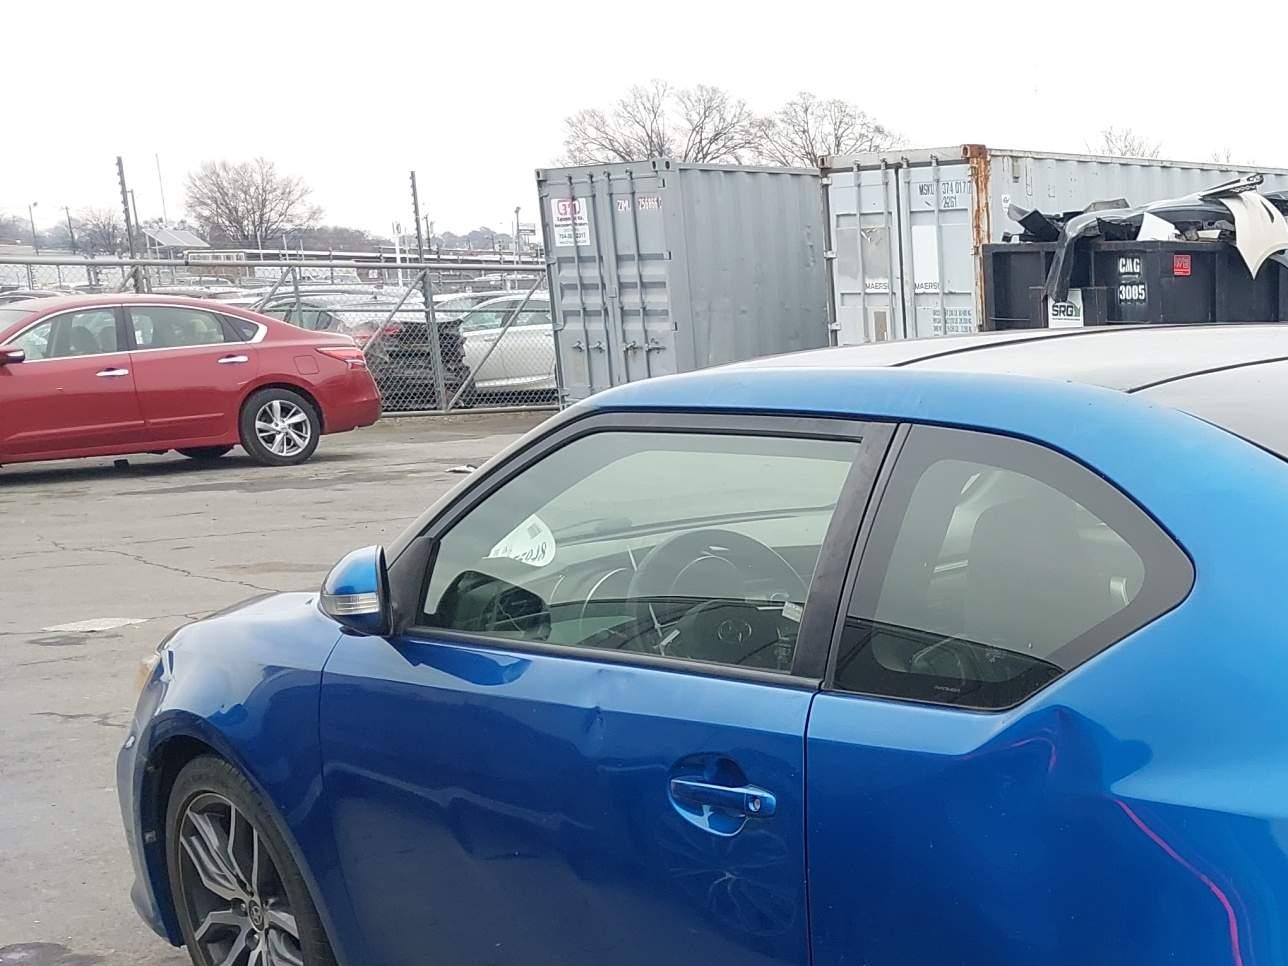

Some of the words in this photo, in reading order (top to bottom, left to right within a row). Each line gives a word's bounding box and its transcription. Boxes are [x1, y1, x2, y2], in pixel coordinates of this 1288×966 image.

[1119, 257, 1140, 273] CMG
[865, 282, 889, 290] MAERS
[915, 281, 940, 290] MAERS
